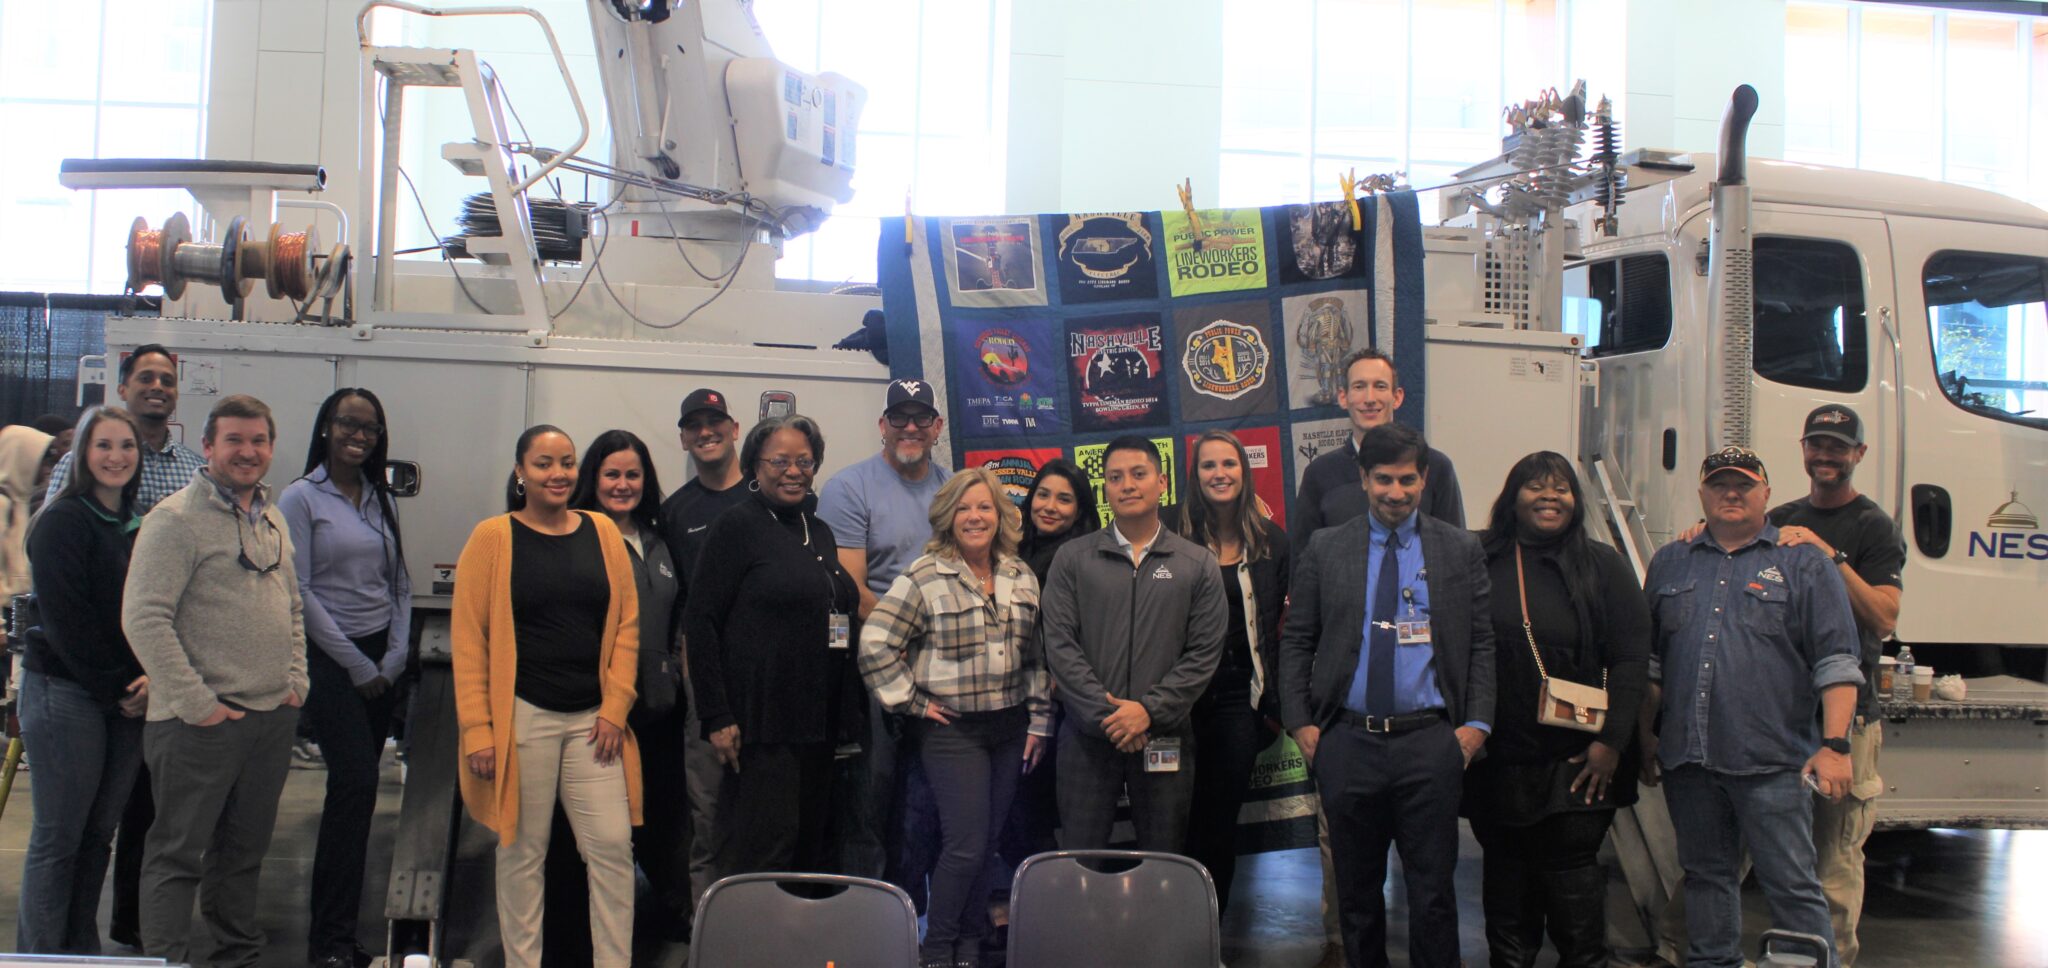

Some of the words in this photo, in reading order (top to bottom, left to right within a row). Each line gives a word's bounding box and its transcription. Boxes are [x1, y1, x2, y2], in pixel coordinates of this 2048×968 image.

[1173, 229, 1212, 242] PUBIC
[1214, 227, 1255, 237] POWER
[1175, 246, 1257, 267] LINEWORKERS
[1178, 260, 1259, 280] RODEO
[1070, 326, 1161, 357] NASHVILLE
[1968, 531, 2048, 560] NES
[1757, 570, 1784, 583] NES
